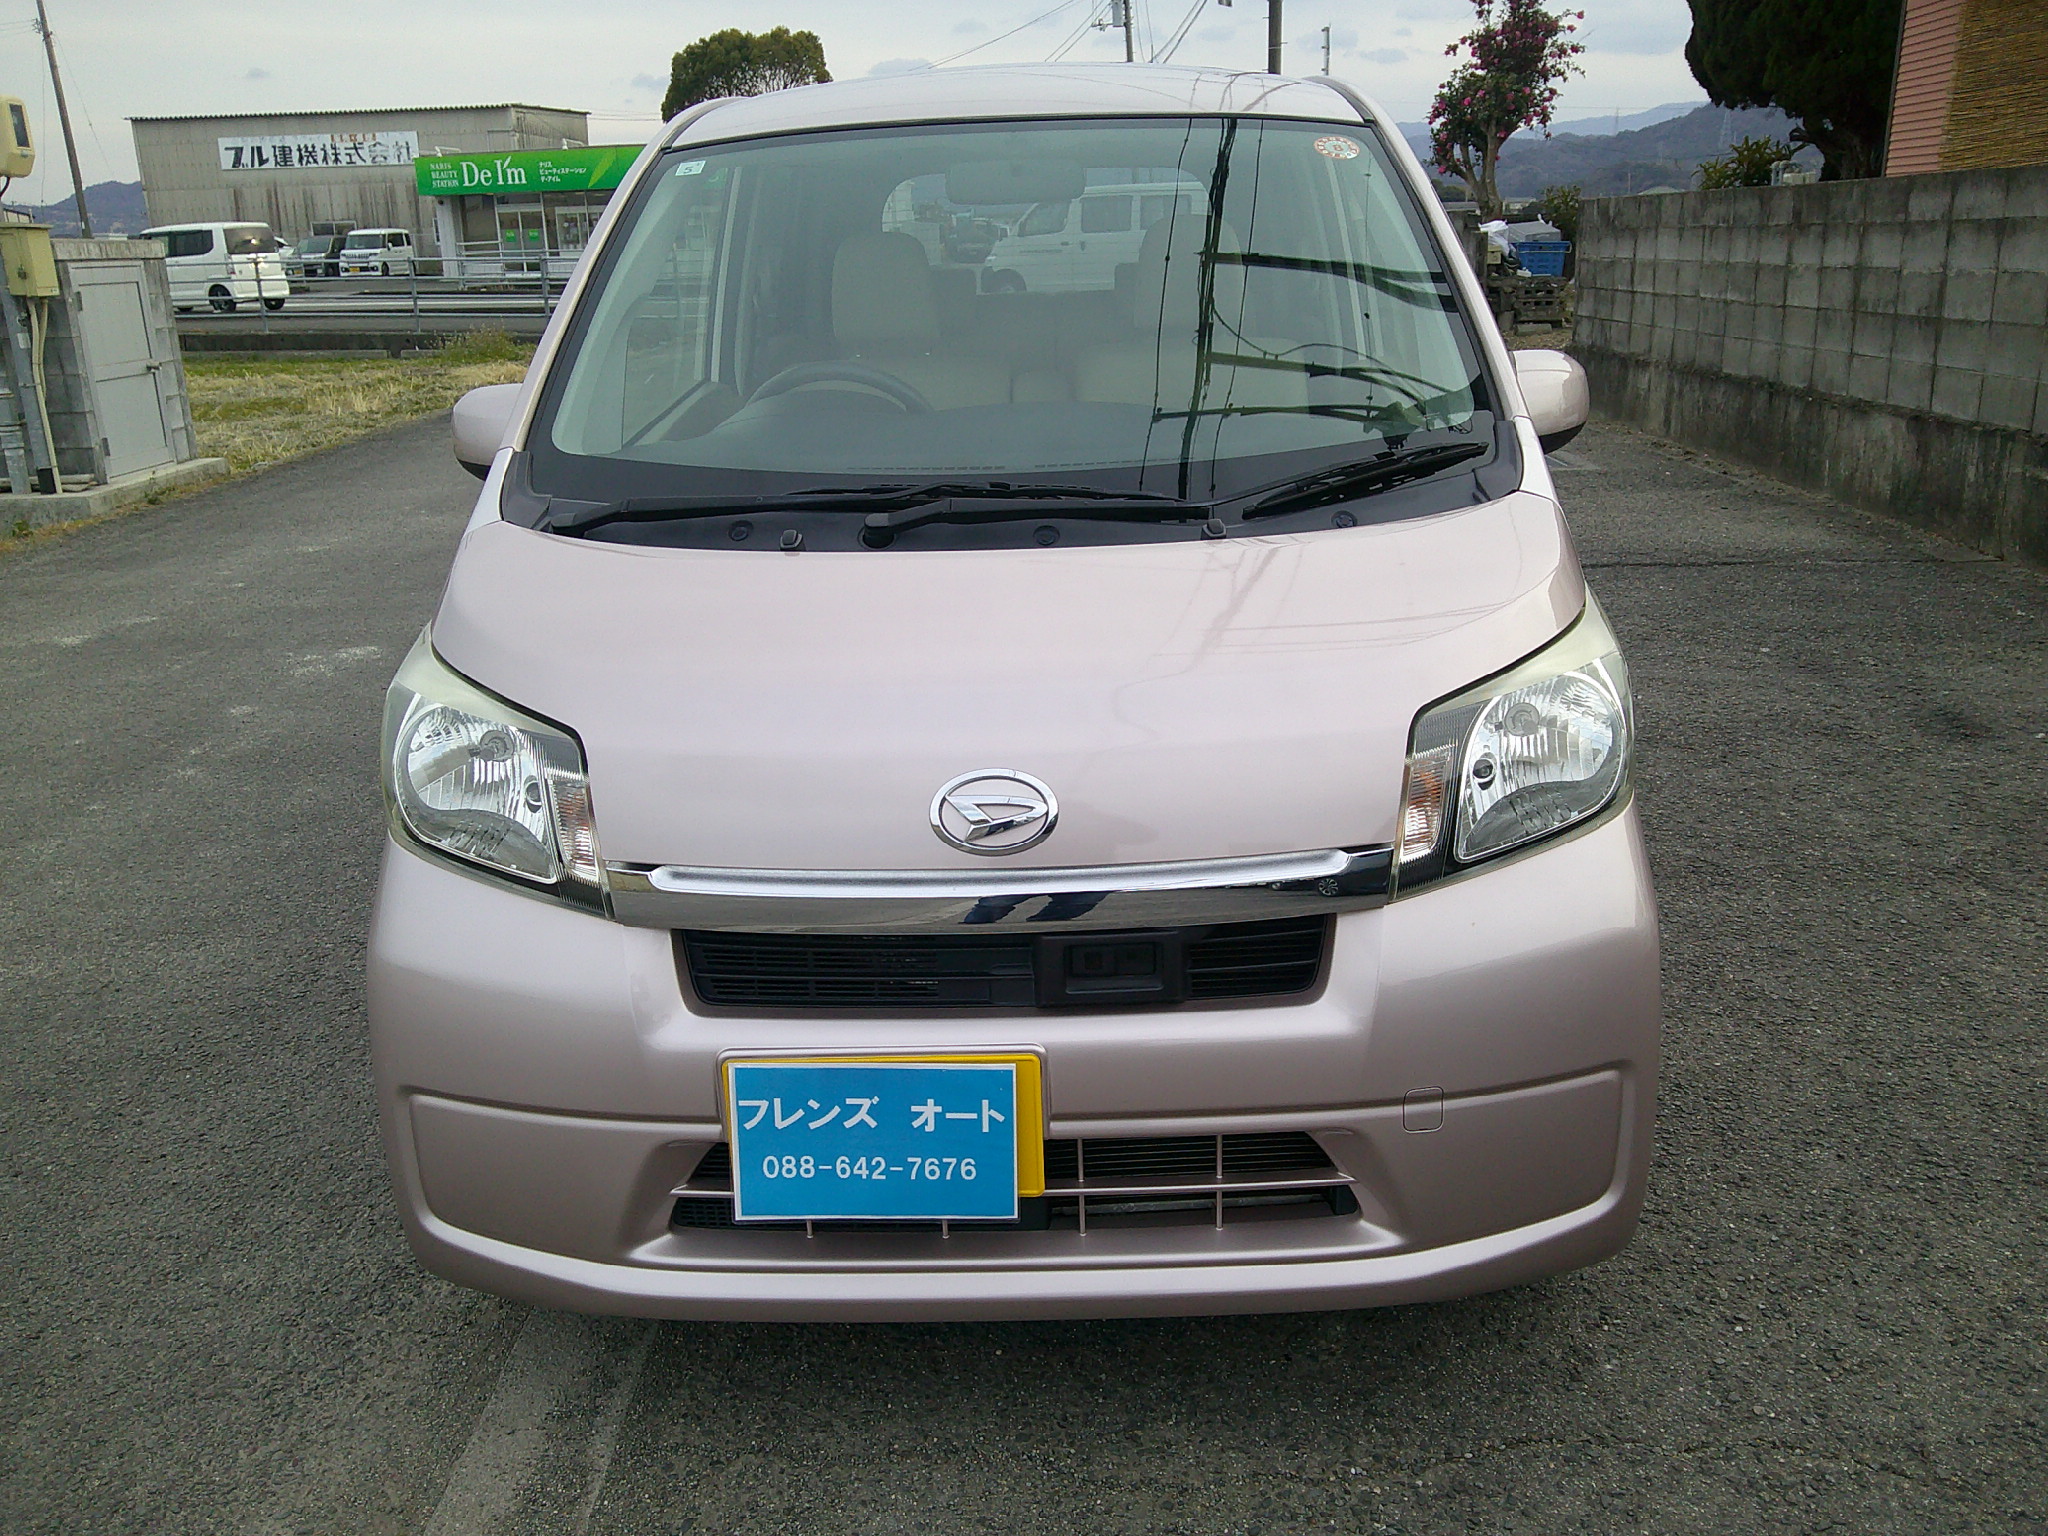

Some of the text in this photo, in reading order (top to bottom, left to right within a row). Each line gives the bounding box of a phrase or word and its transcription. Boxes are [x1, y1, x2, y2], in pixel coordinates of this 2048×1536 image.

[431, 170, 458, 179] BEAUTY
[432, 179, 459, 188] STATION
[460, 161, 492, 187] De
[738, 1096, 1006, 1133] フレンズ オート
[762, 1155, 977, 1181] 088-642-7676
